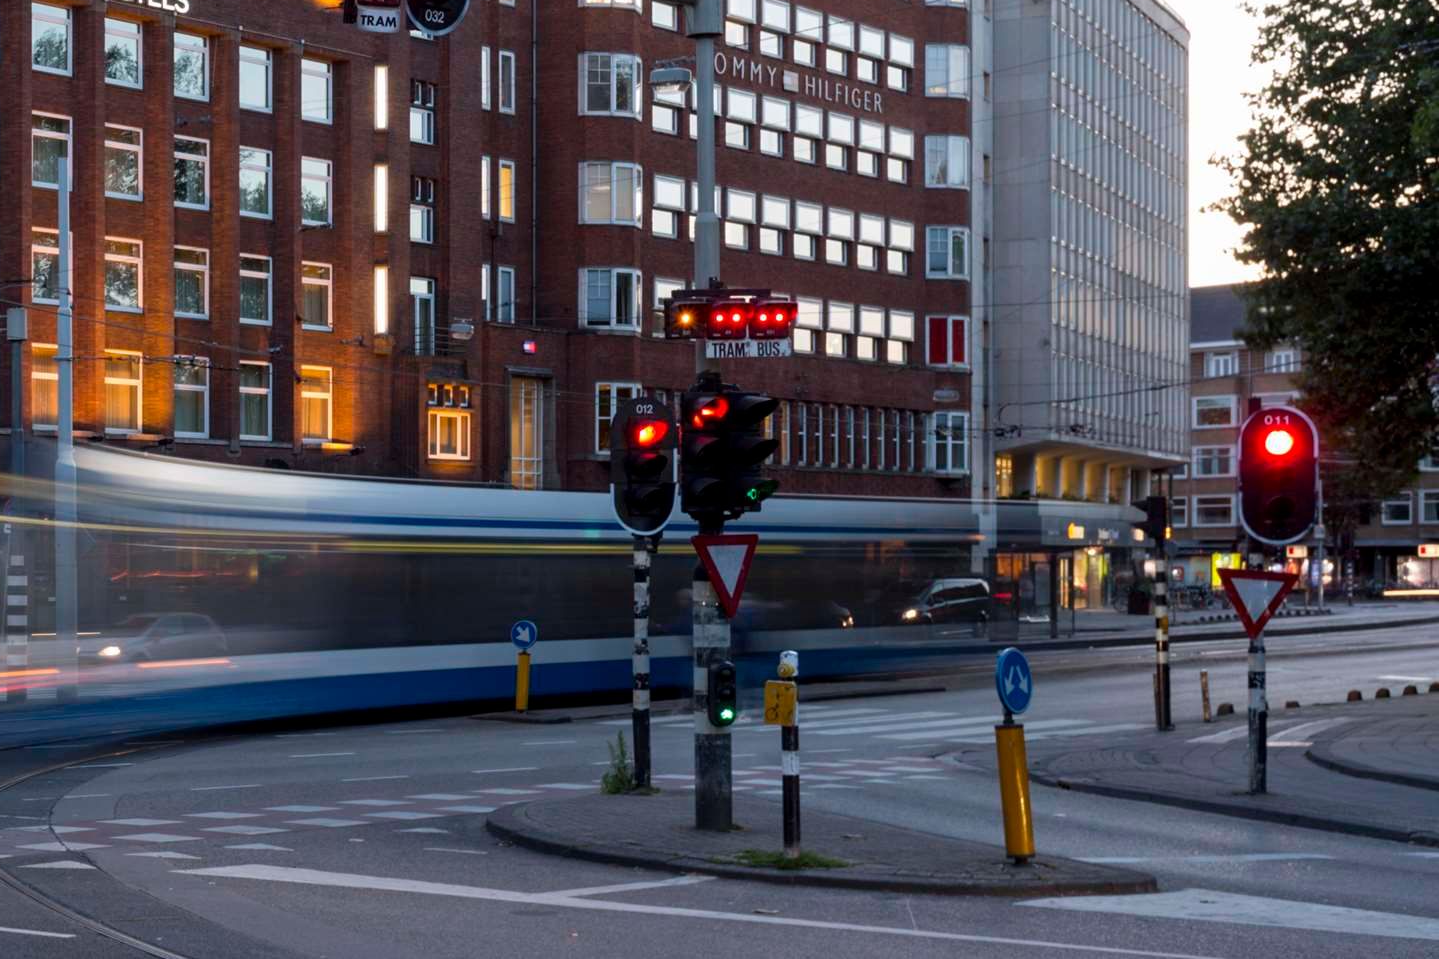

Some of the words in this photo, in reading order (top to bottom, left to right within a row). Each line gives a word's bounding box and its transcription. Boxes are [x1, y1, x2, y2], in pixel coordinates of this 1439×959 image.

[361, 14, 397, 28] TRAM
[425, 9, 444, 23] 032
[714, 52, 777, 87] OMMY
[804, 75, 883, 113] HILFIGER
[712, 342, 745, 356] TRAM
[757, 342, 780, 356] BUS
[636, 404, 654, 414] 012
[1264, 415, 1289, 425] 011
